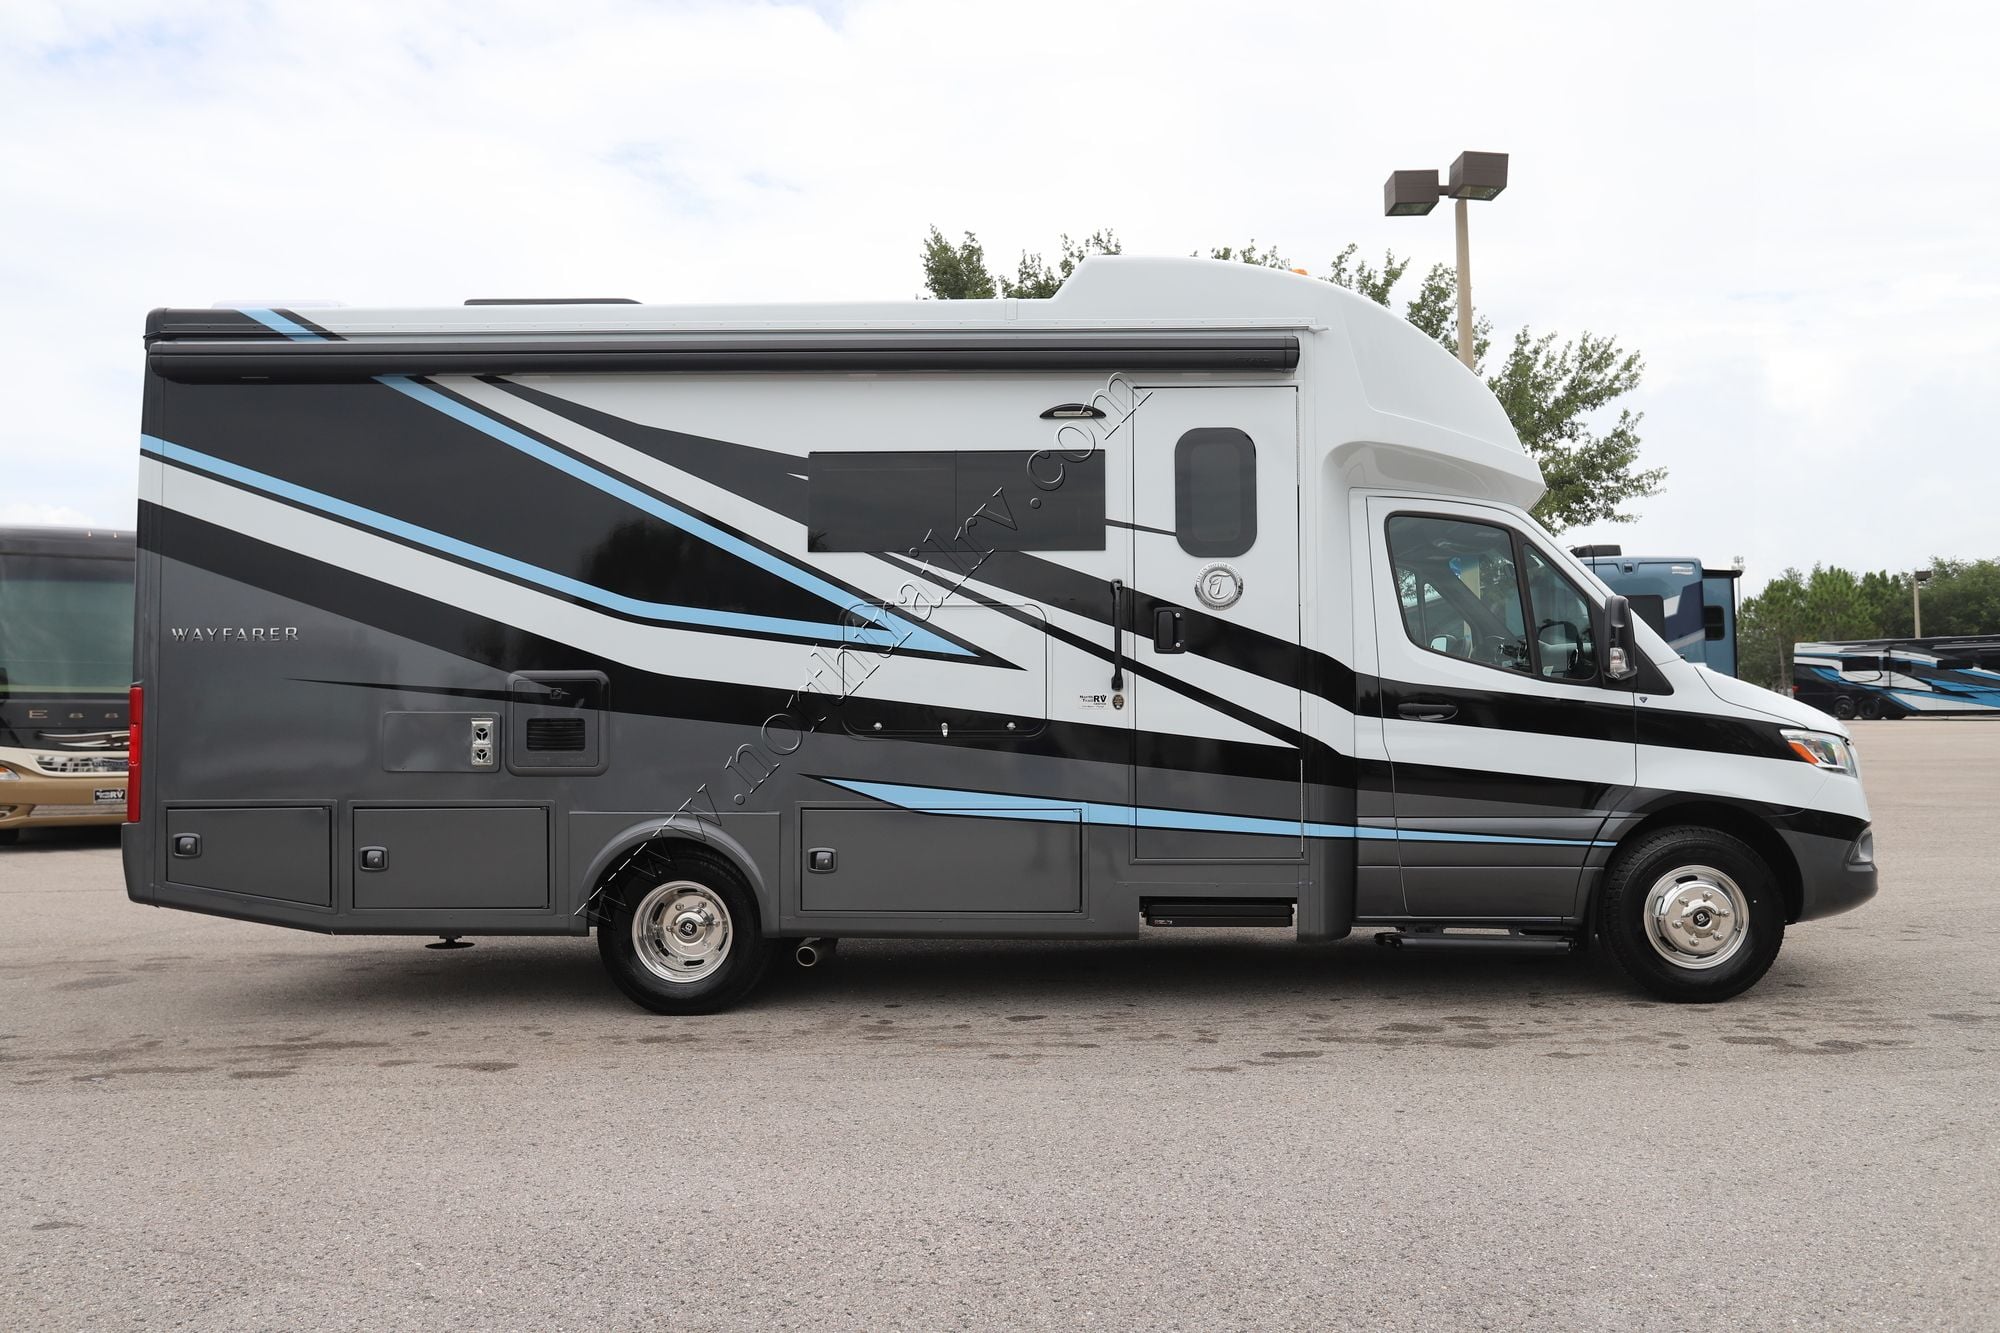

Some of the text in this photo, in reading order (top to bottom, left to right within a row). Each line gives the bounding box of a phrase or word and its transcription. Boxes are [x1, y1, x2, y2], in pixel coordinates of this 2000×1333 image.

[171, 626, 299, 642] WAYFARER
[1093, 694, 1107, 703] RV
[110, 790, 124, 798] RV
